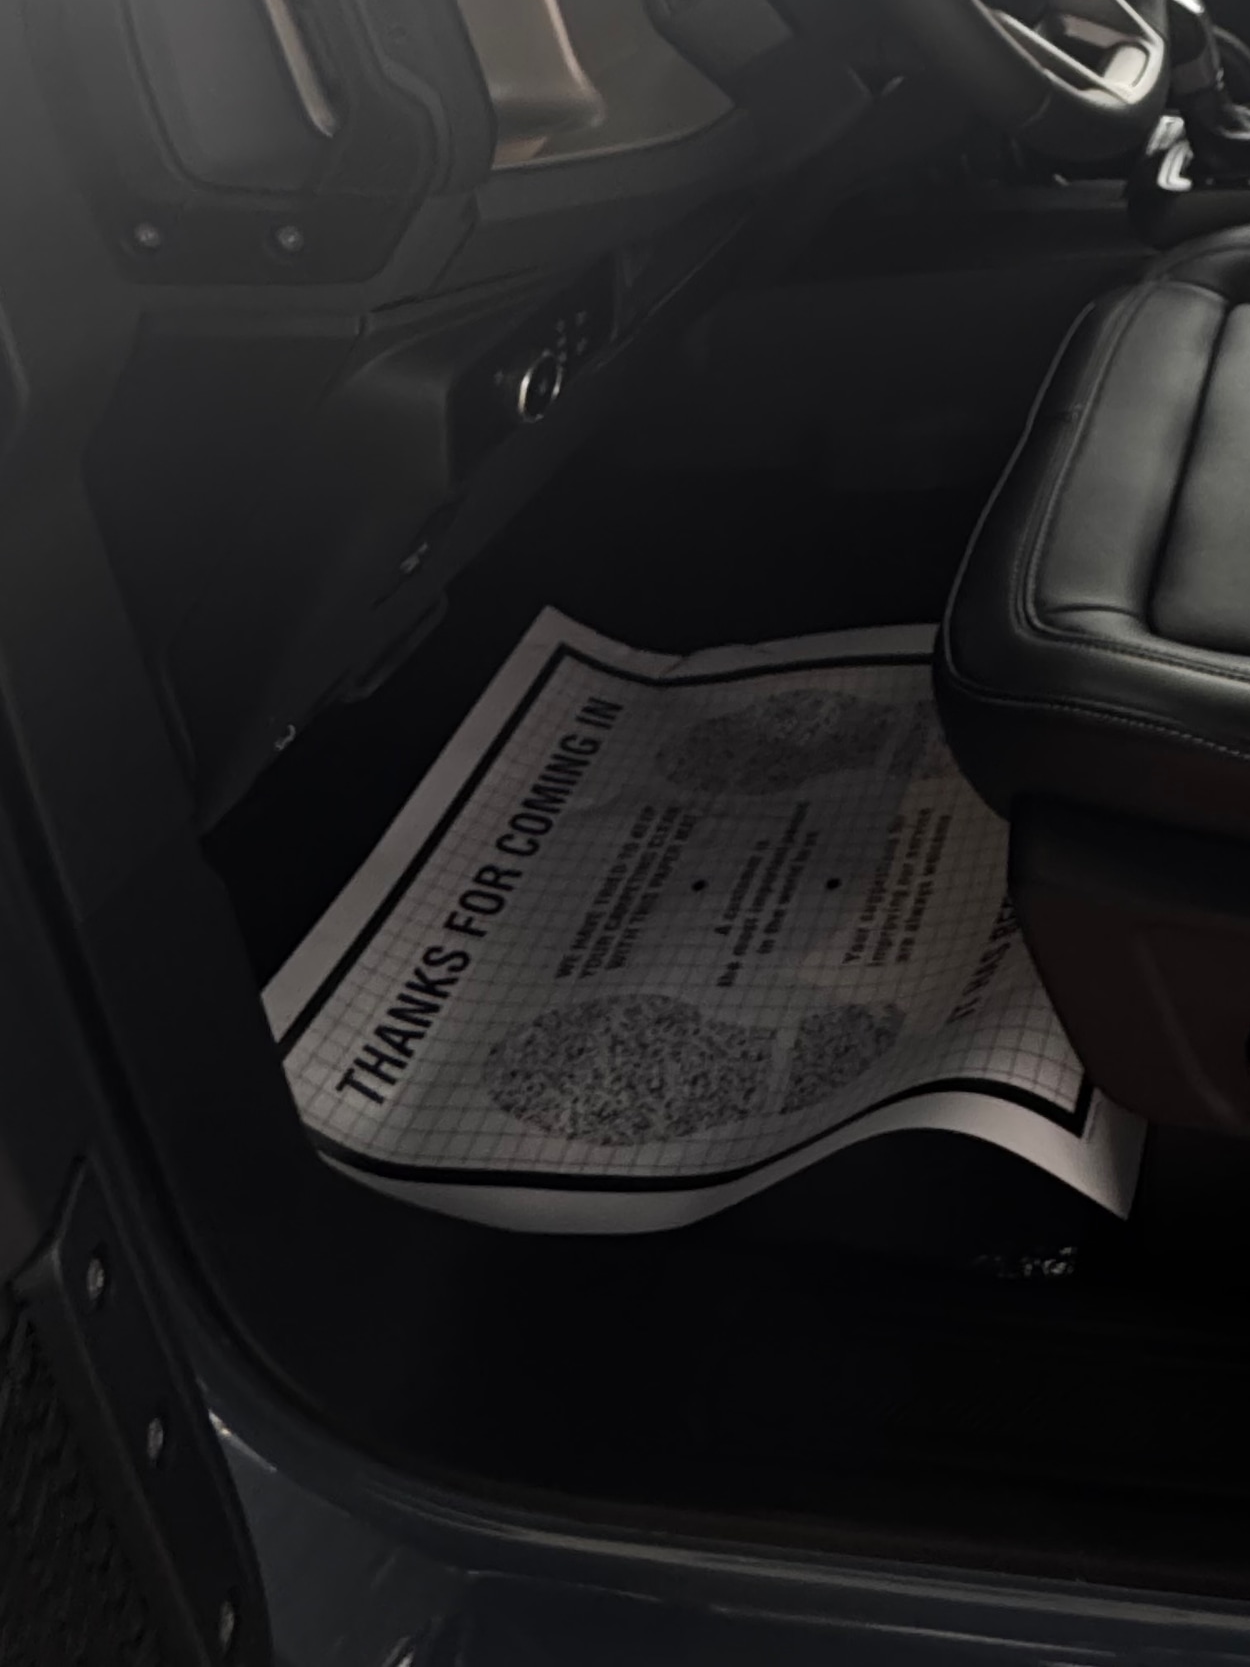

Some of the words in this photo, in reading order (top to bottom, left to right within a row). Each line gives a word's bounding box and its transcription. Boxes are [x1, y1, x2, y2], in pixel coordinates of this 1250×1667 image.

[336, 946, 470, 1104] THANKS
[444, 865, 522, 938] FOR
[496, 734, 600, 857] COMING
[576, 697, 623, 730] IN
